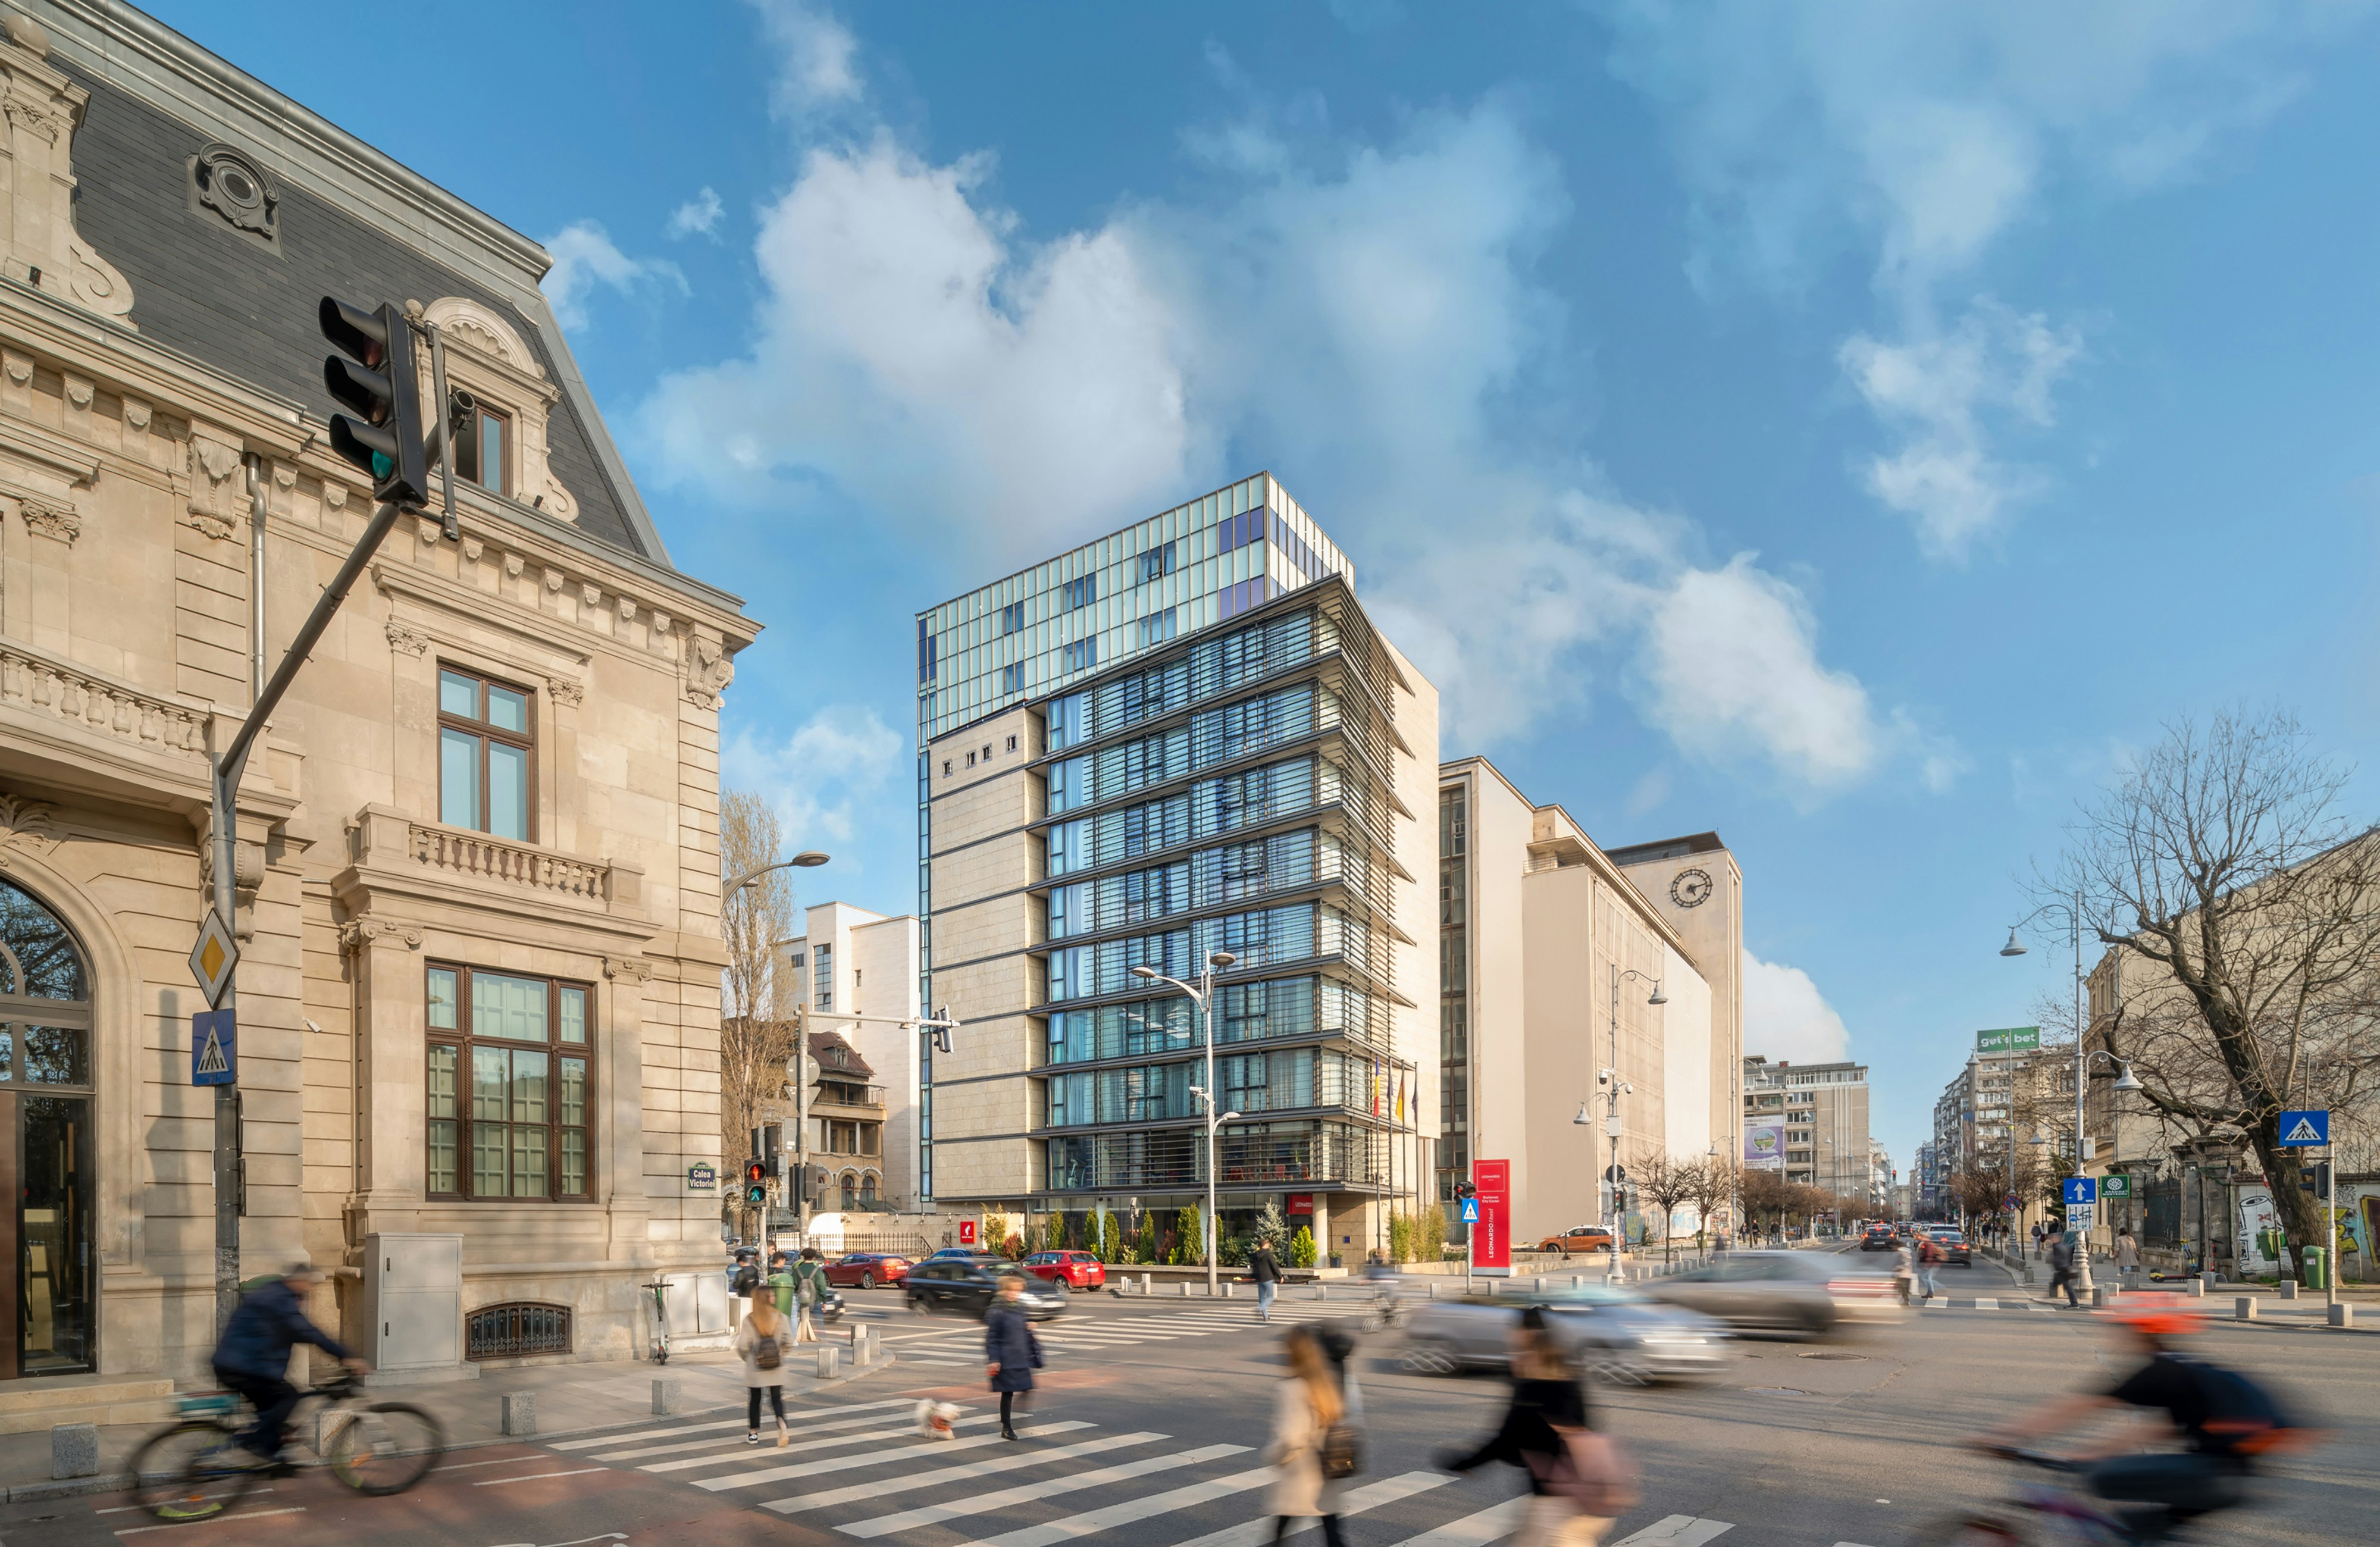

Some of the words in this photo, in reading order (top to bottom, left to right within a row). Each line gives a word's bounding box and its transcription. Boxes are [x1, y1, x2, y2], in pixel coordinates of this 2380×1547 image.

[2014, 1034, 2035, 1043] bet
[694, 1170, 710, 1178] Calea
[690, 1179, 715, 1188] Victoriei
